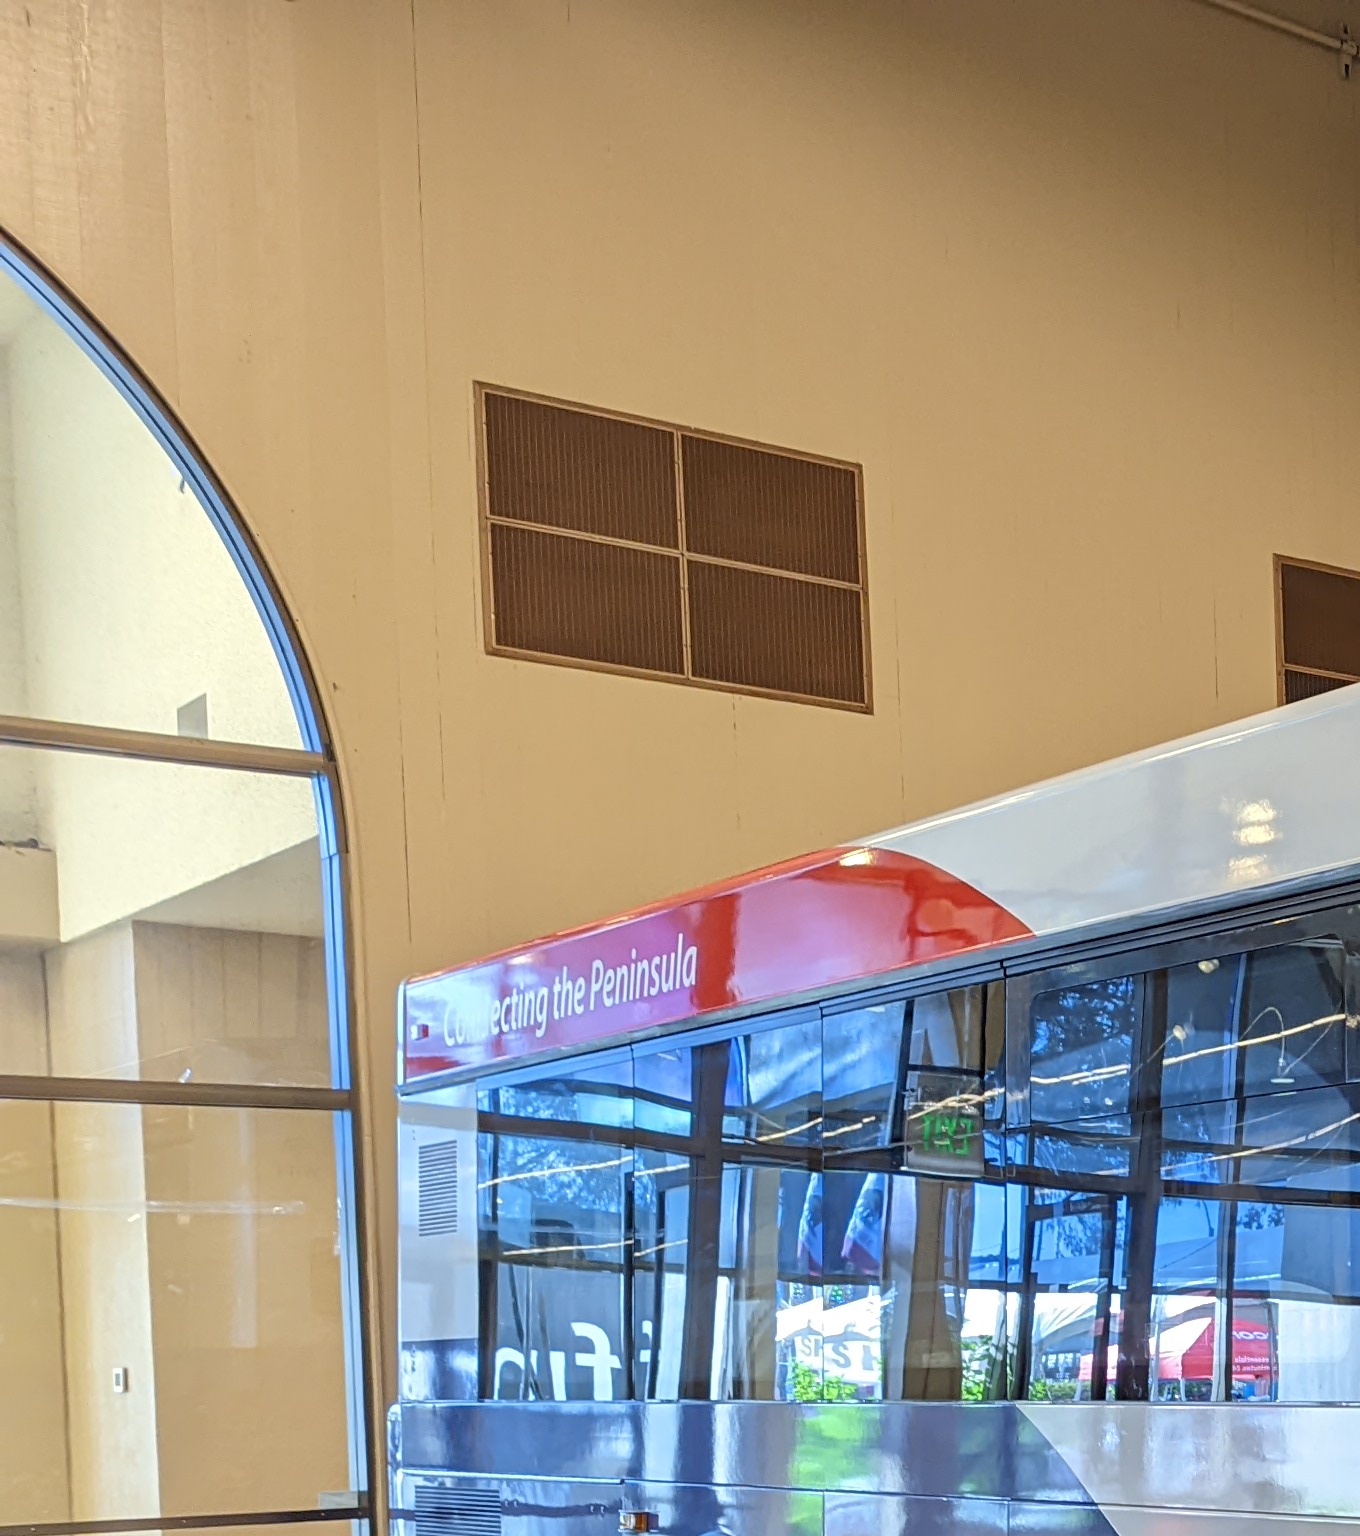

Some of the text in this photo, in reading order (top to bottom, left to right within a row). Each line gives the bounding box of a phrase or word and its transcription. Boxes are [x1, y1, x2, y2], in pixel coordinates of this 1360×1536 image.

[443, 932, 698, 1047] Coecting the Peninsula
